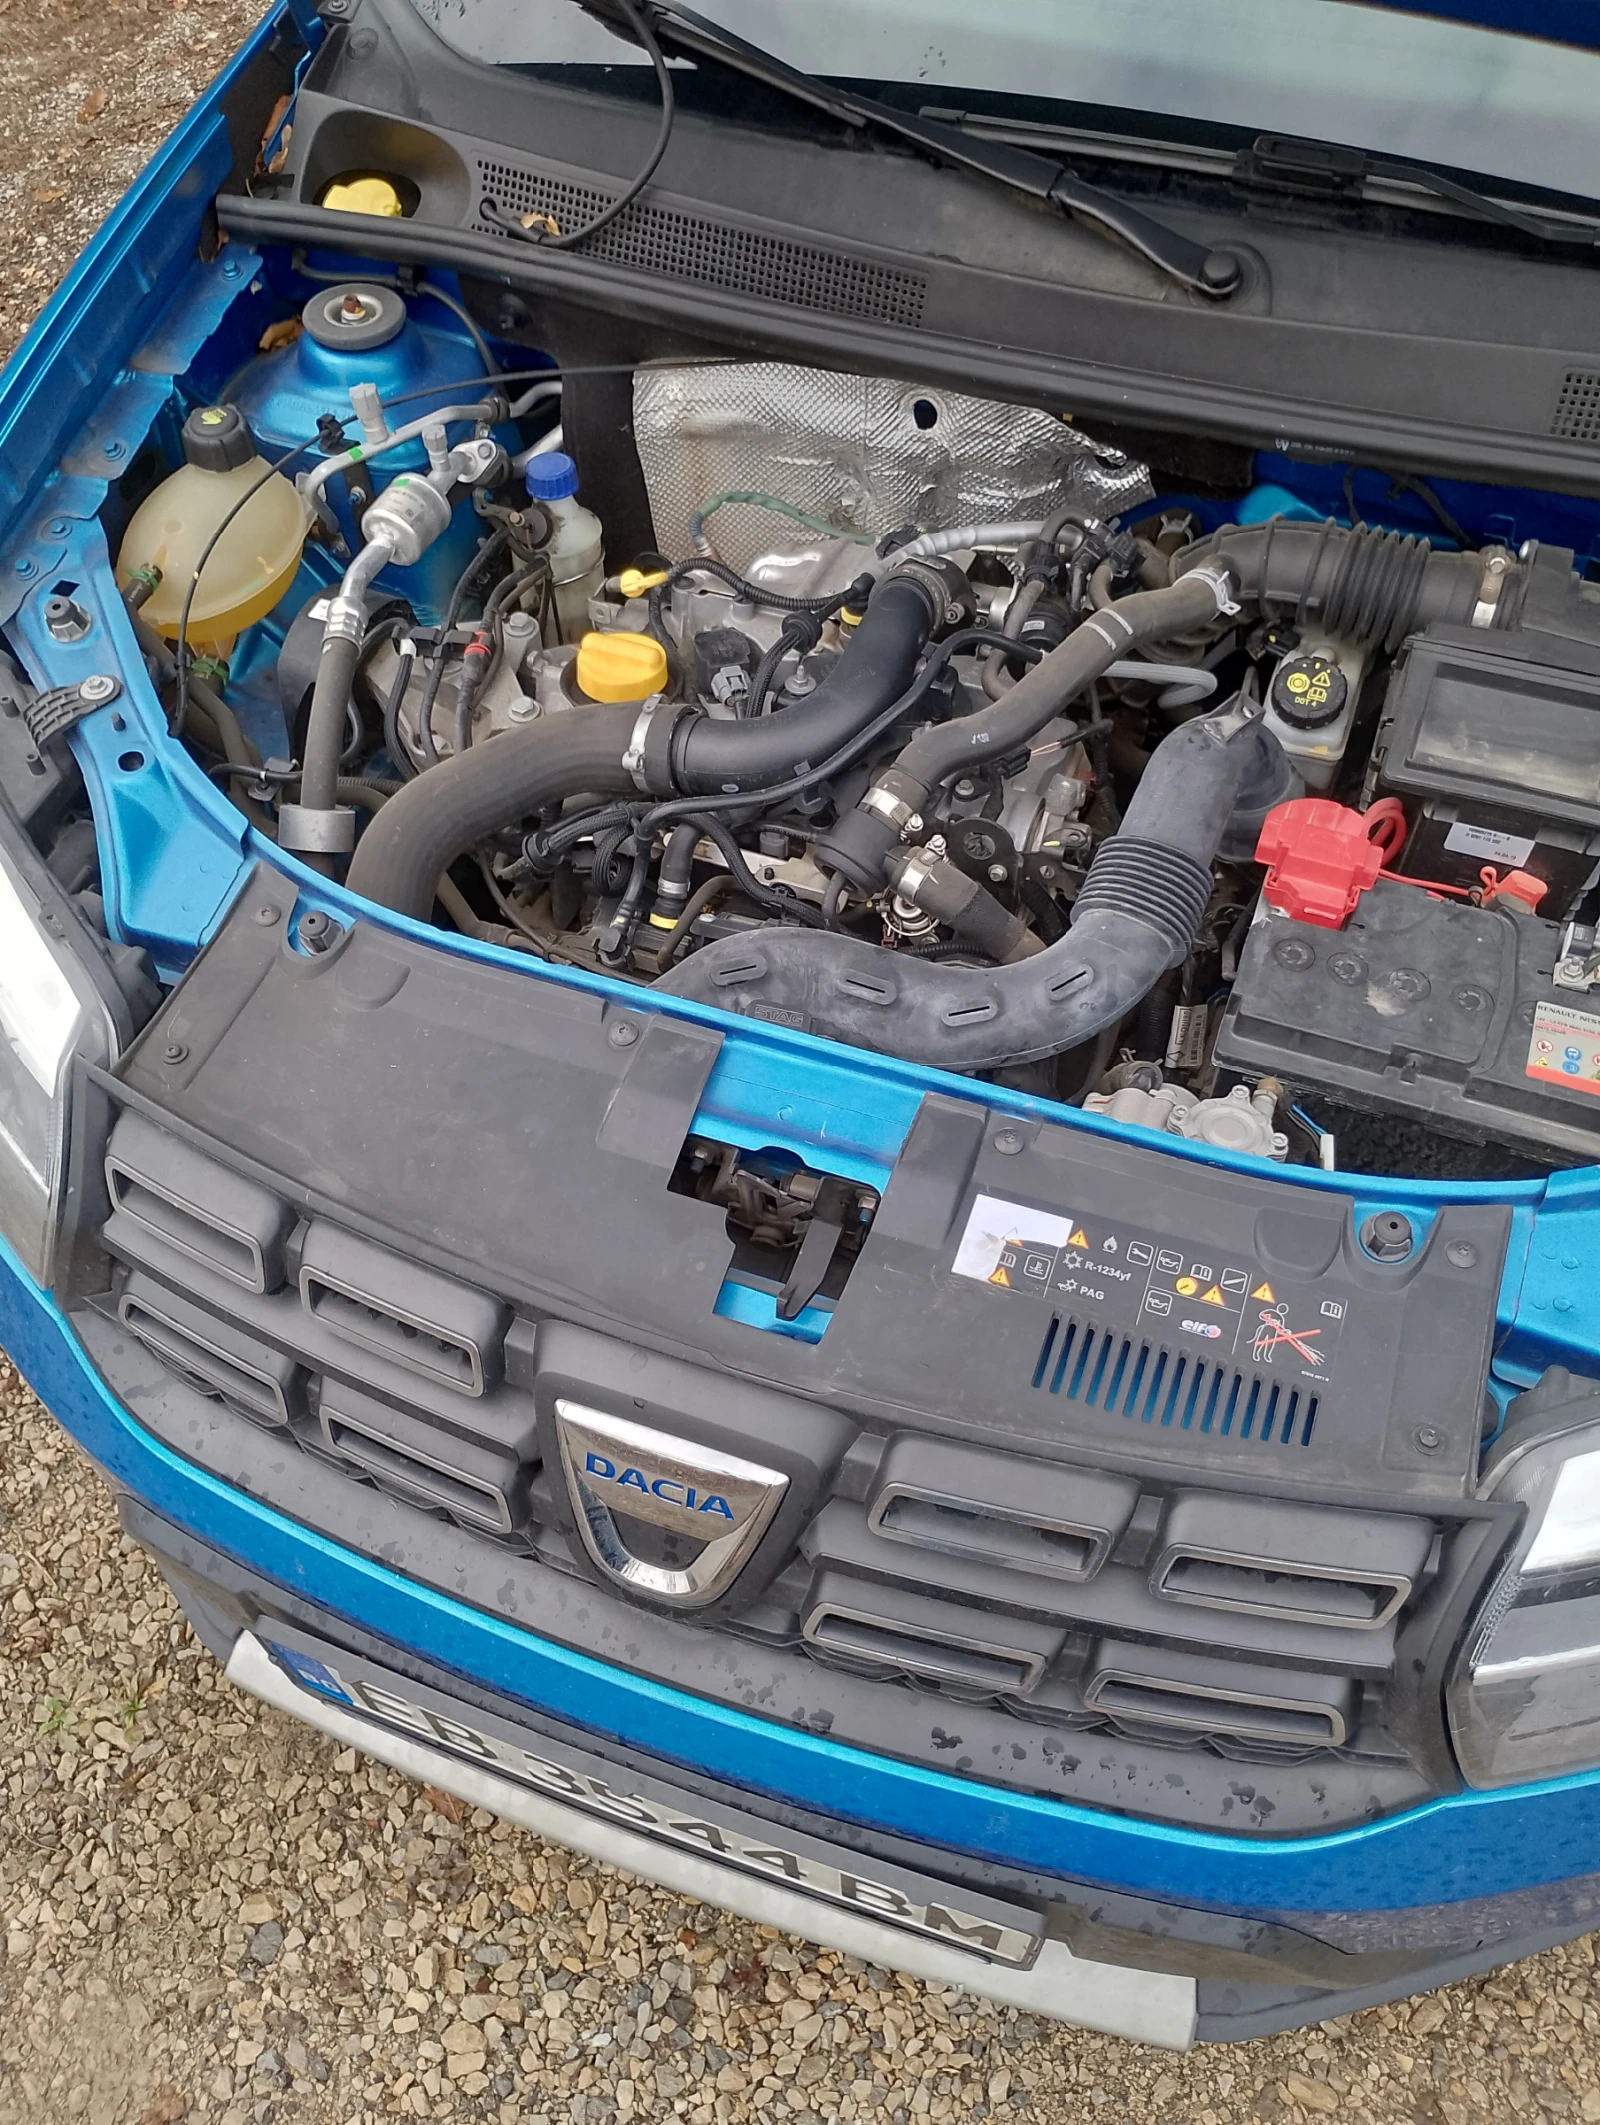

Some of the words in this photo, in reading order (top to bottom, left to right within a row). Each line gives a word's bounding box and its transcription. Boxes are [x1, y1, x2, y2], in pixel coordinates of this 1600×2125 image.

[1294, 696, 1310, 706] DOT
[755, 1006, 804, 1026] STAG
[1537, 1004, 1577, 1019] RENAULT
[1084, 1260, 1132, 1281] R-1234yf
[1080, 1286, 1105, 1300] PAG
[1181, 1319, 1208, 1333] elf
[585, 1451, 735, 1521] DACIA
[352, 1680, 498, 1760] EB
[523, 1752, 807, 1880] 3544
[840, 1872, 1003, 1951] BM
